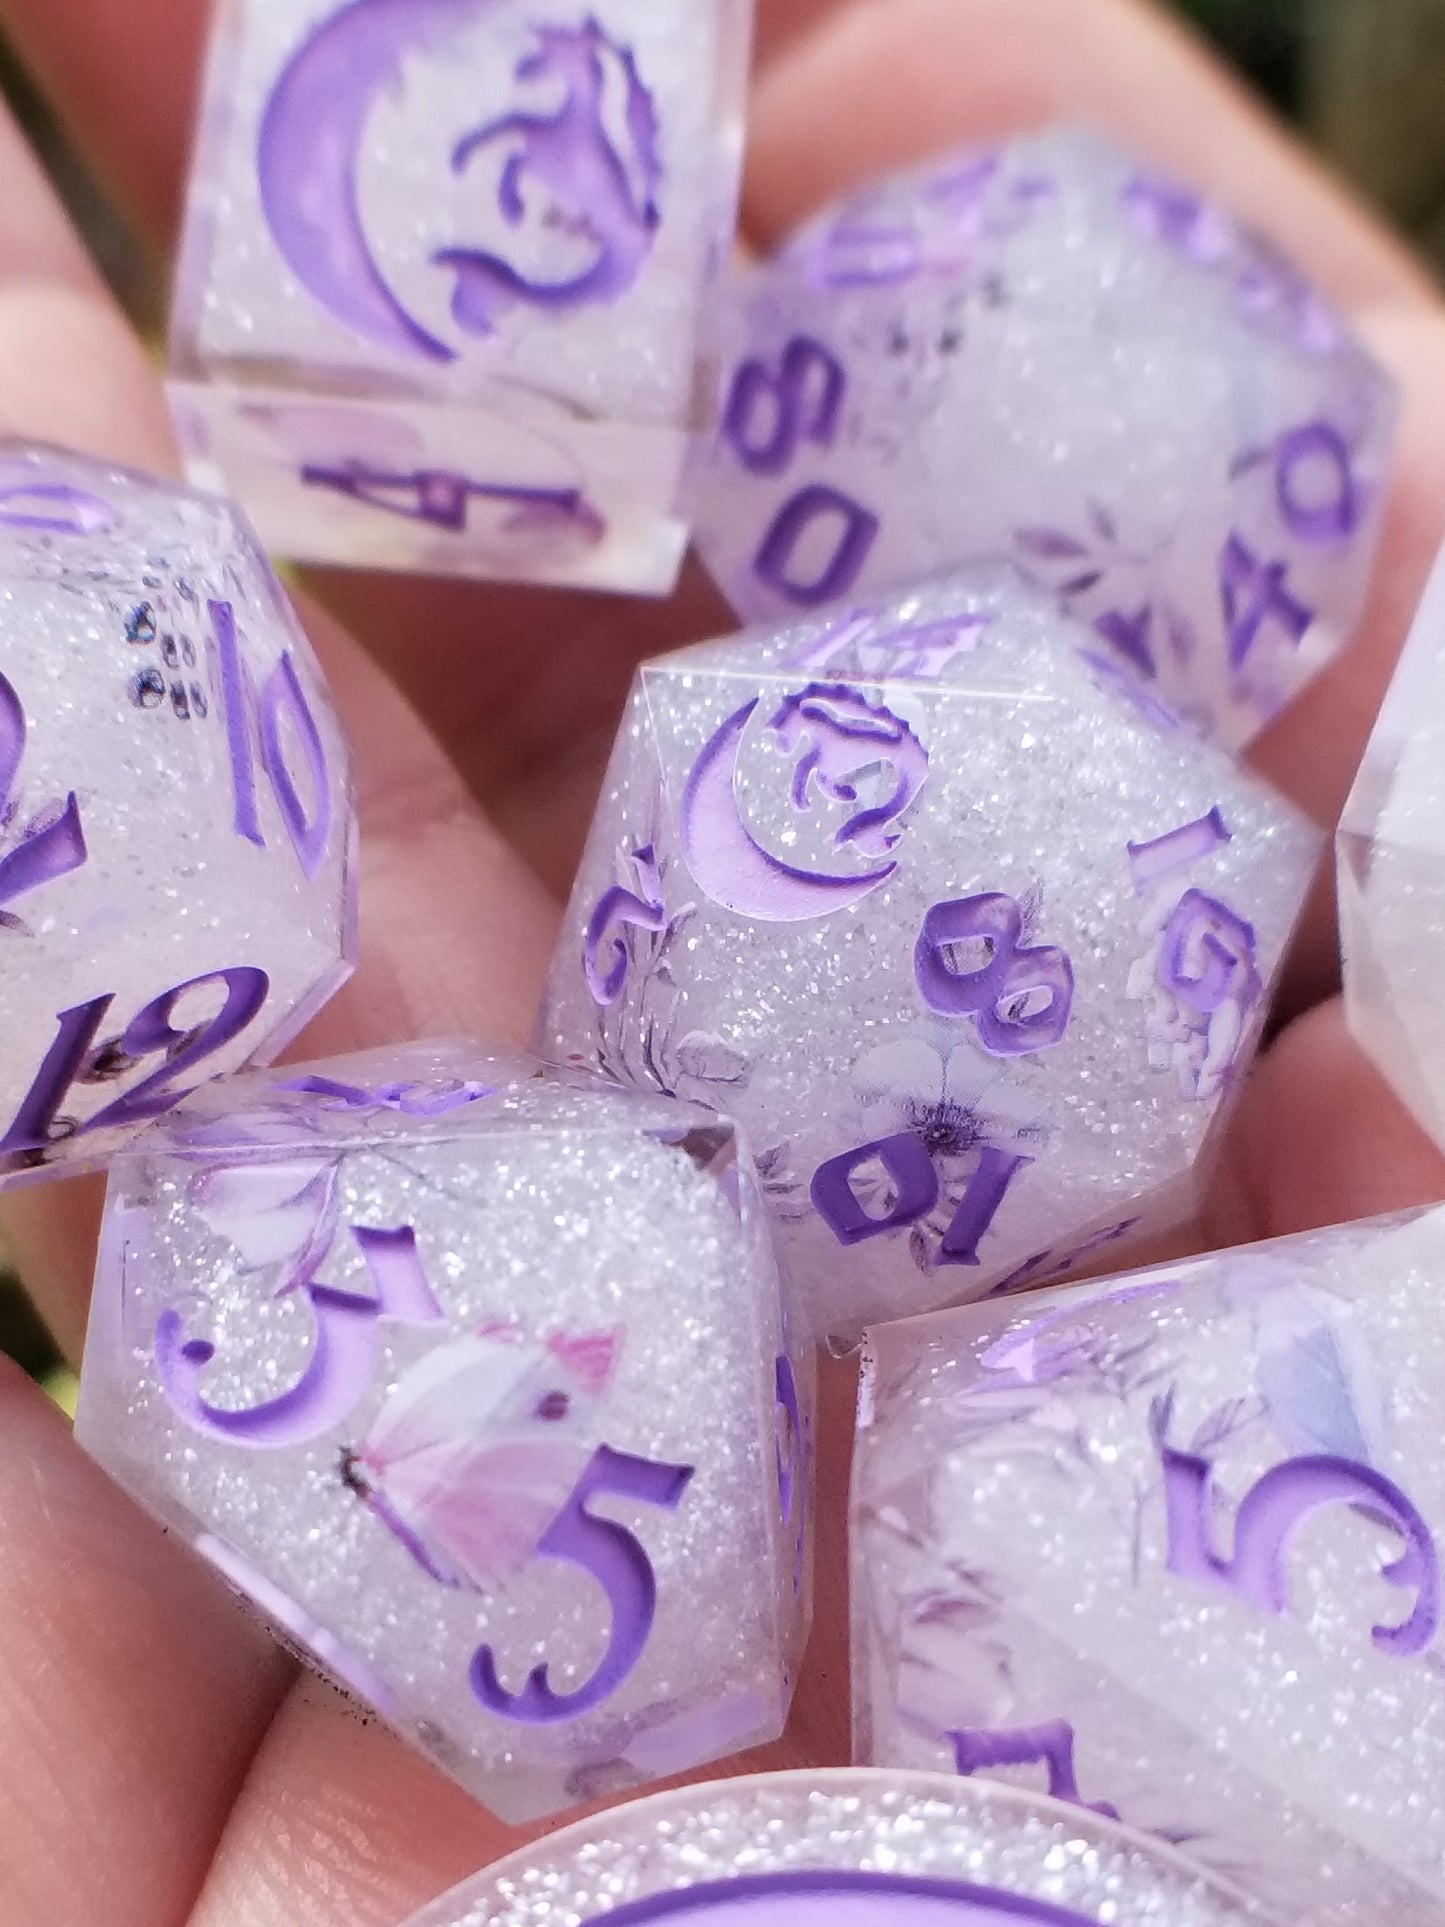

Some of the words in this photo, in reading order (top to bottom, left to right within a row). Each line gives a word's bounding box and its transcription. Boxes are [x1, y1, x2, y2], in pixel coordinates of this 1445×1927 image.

[208, 600, 331, 880] 10
[0, 965, 270, 1150] 12
[914, 890, 1075, 1058] 8
[810, 1130, 1034, 1267] 10
[469, 1443, 696, 1724] 5
[1160, 1447, 1439, 1658] 5
